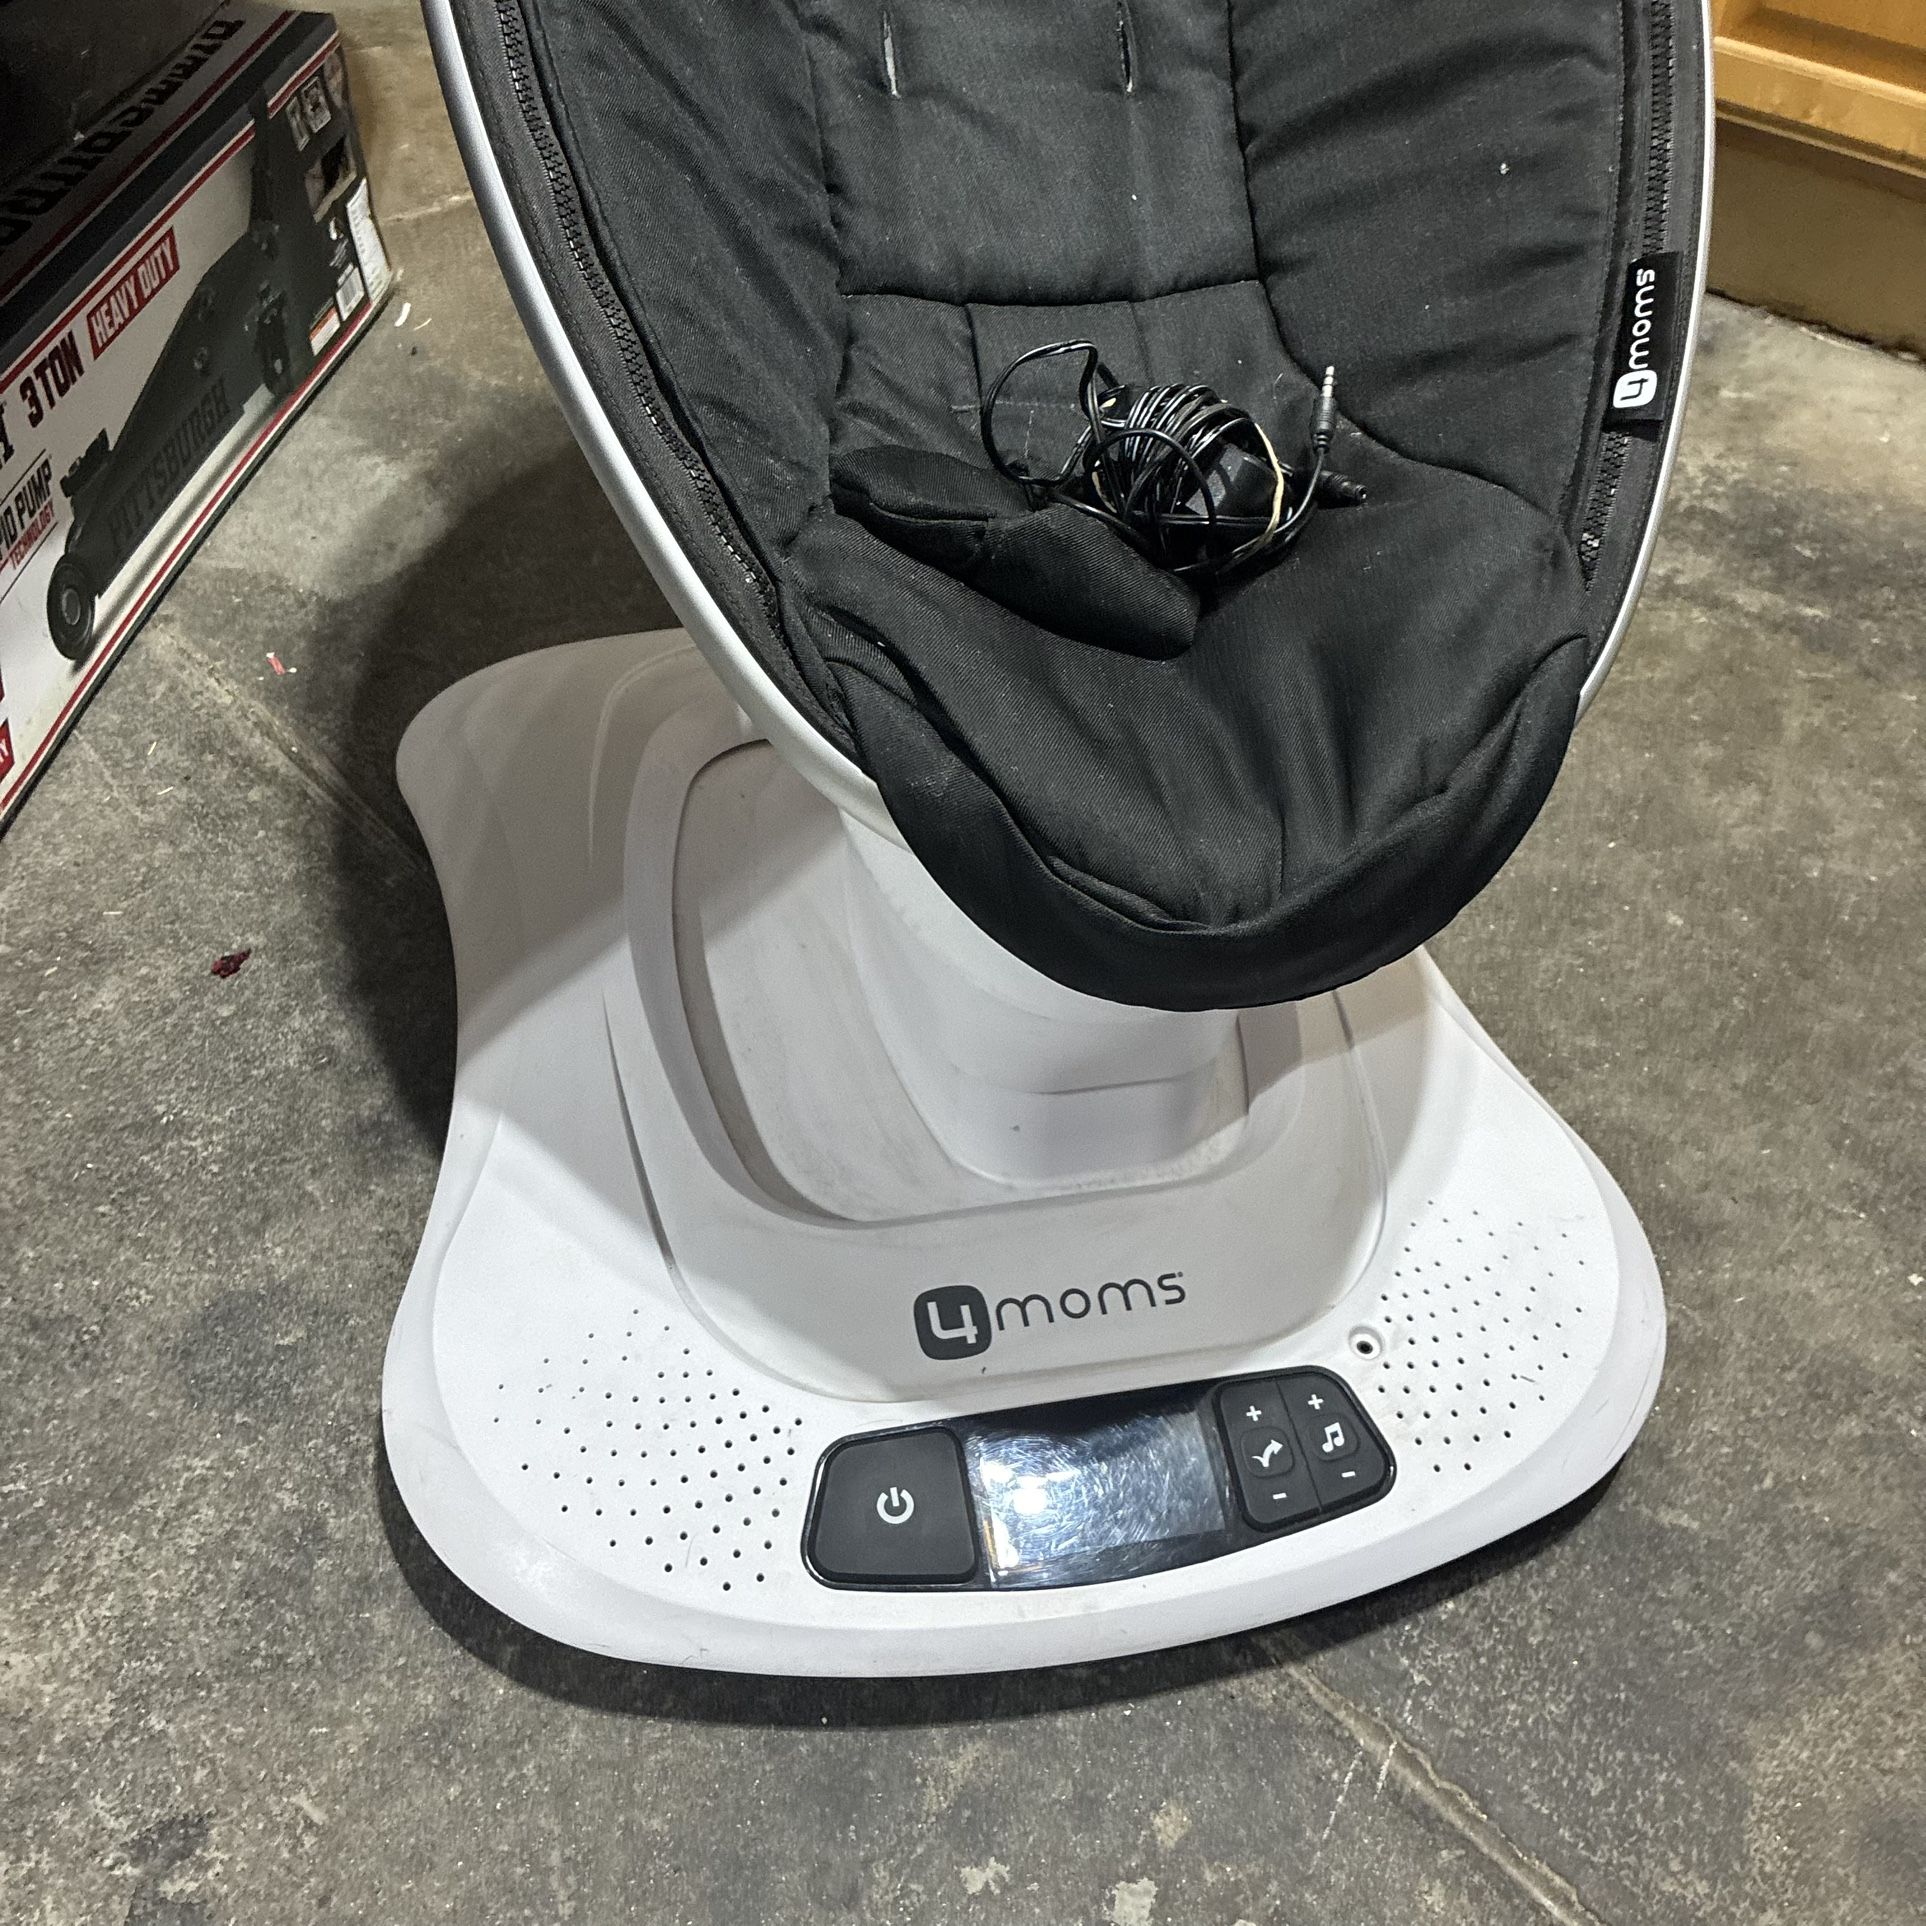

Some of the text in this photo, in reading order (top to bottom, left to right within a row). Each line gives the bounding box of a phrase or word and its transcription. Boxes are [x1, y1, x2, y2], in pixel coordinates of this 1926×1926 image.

[91, 237, 174, 350] HEAVY DUTY
[1613, 268, 1657, 408] 4moms
[15, 457, 53, 530] PUMP
[109, 378, 230, 556] PITTSBURGH
[9, 499, 55, 570] TECHNOLOGY
[914, 1271, 1187, 1360] 4moms
